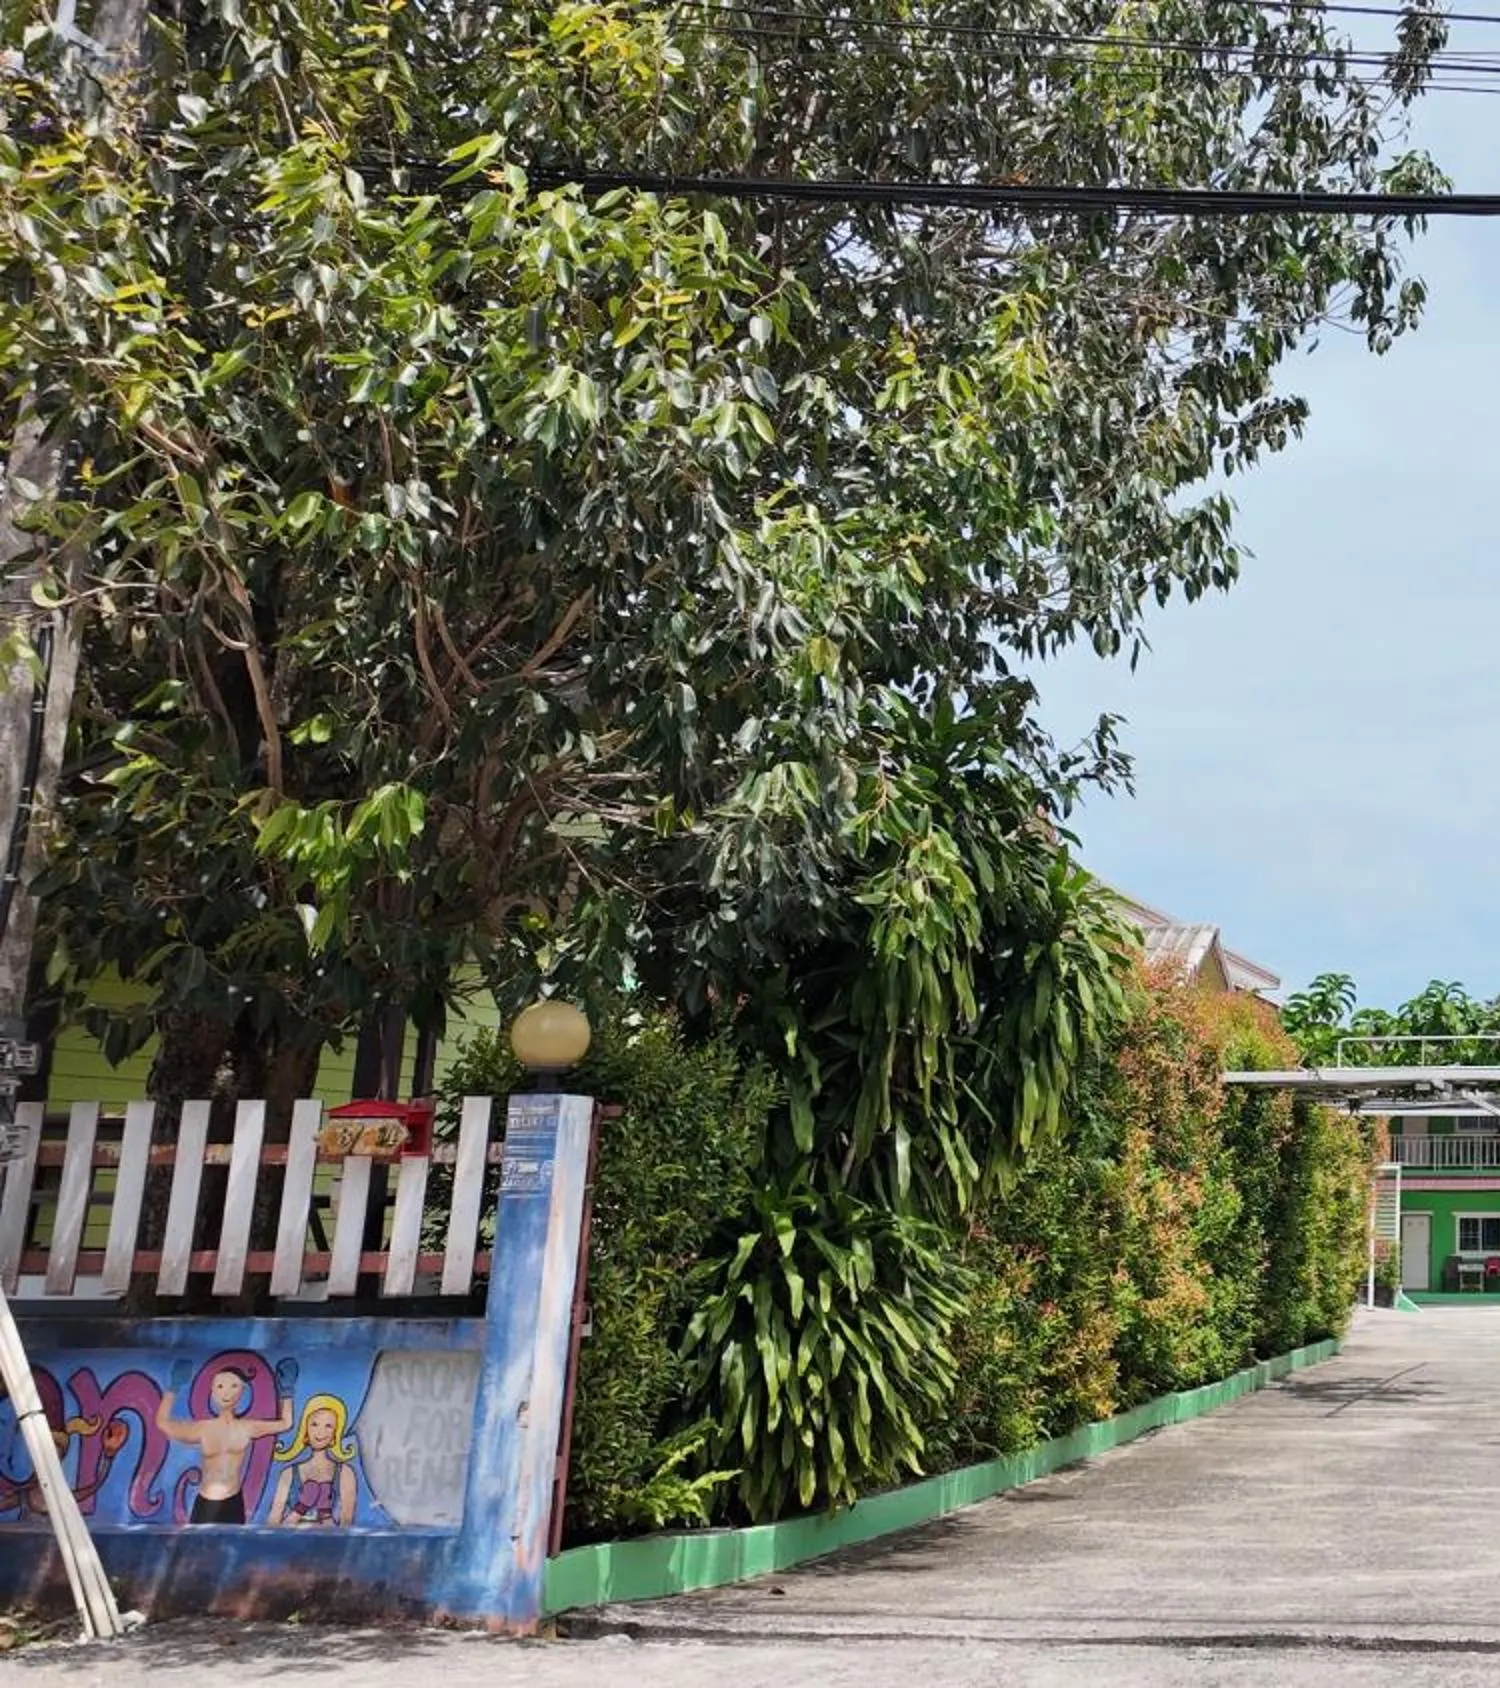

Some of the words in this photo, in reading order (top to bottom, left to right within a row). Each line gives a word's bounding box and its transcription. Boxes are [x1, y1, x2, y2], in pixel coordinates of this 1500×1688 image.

[383, 1361, 475, 1406] ROOM
[402, 1405, 465, 1453] FOR
[383, 1451, 466, 1500] RENT
